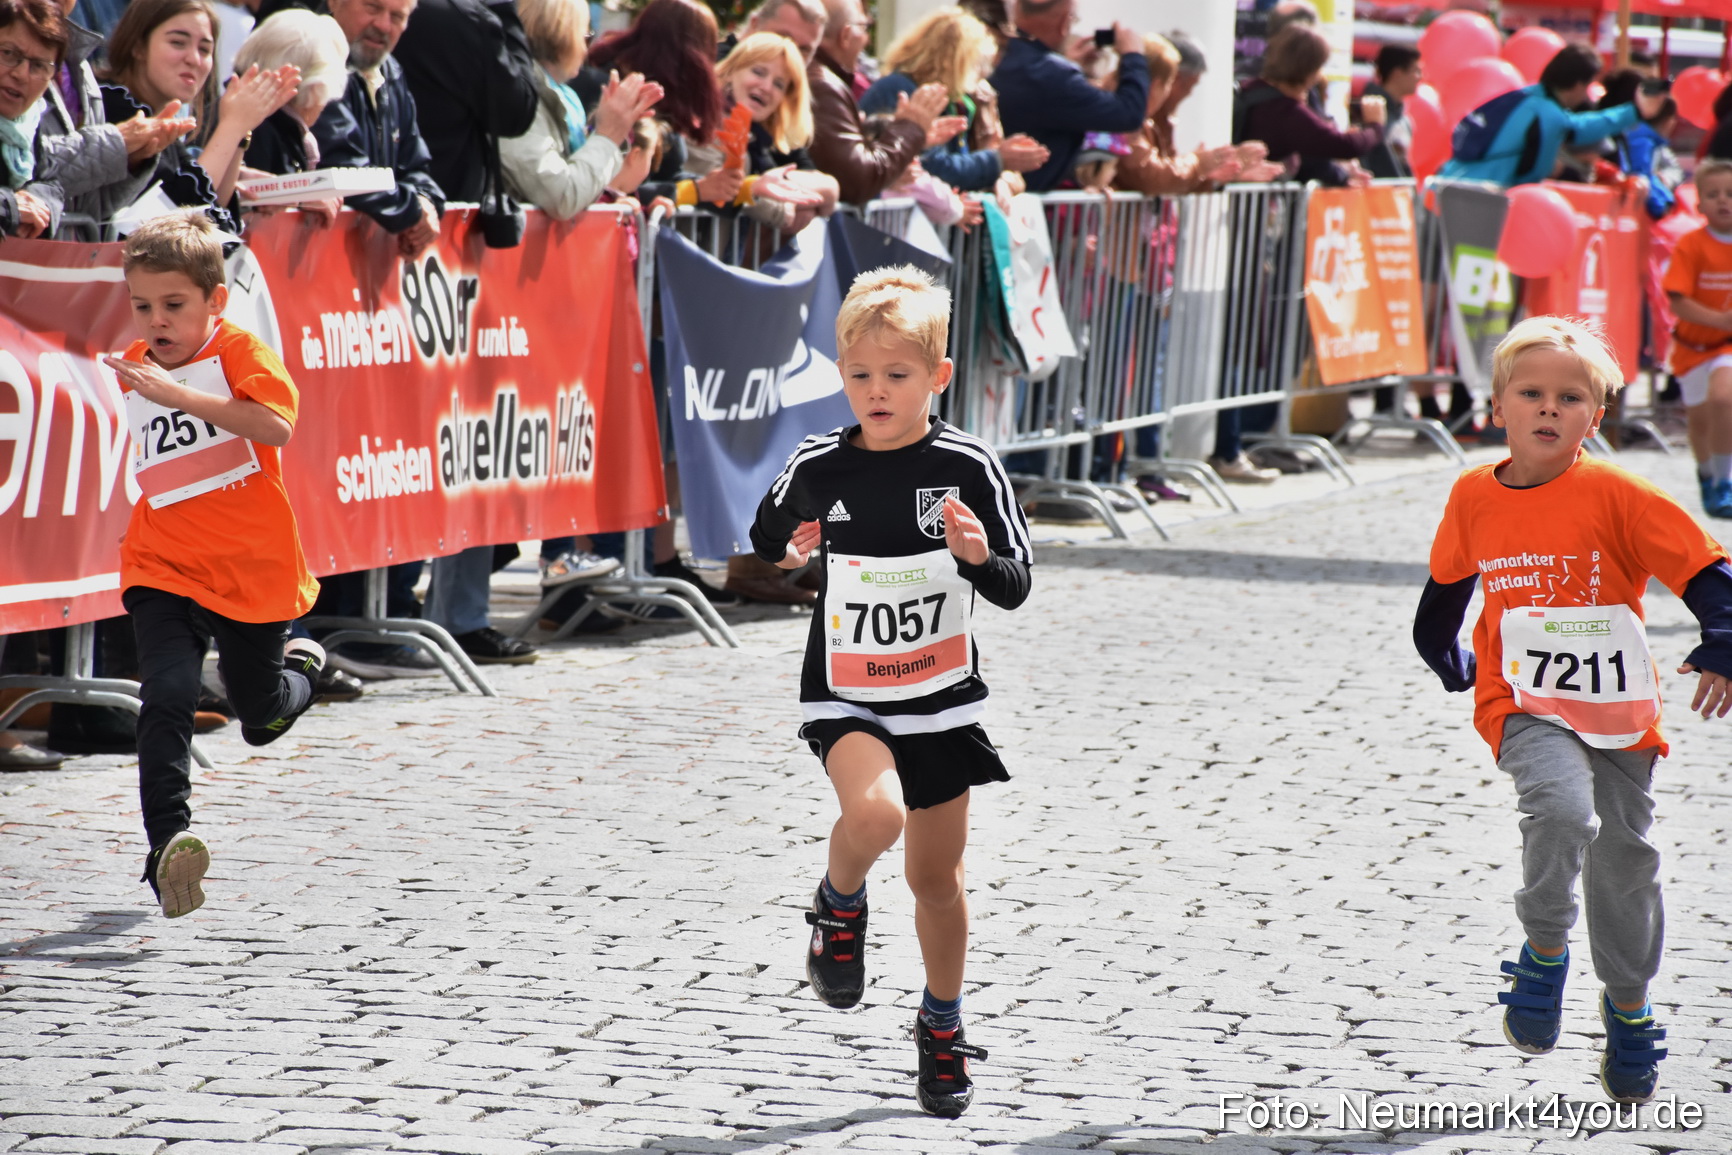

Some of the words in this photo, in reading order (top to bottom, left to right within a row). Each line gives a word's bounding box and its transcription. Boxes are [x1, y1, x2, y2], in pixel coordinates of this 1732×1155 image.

[320, 288, 411, 368] meisen
[477, 317, 508, 357] und
[555, 390, 593, 474] Hits
[827, 513, 851, 522] adidas
[875, 568, 927, 583] BOCK
[845, 592, 947, 646] 7057
[1560, 620, 1611, 633] BOCK
[866, 654, 936, 679] Benjamin
[1526, 649, 1626, 694] 7211
